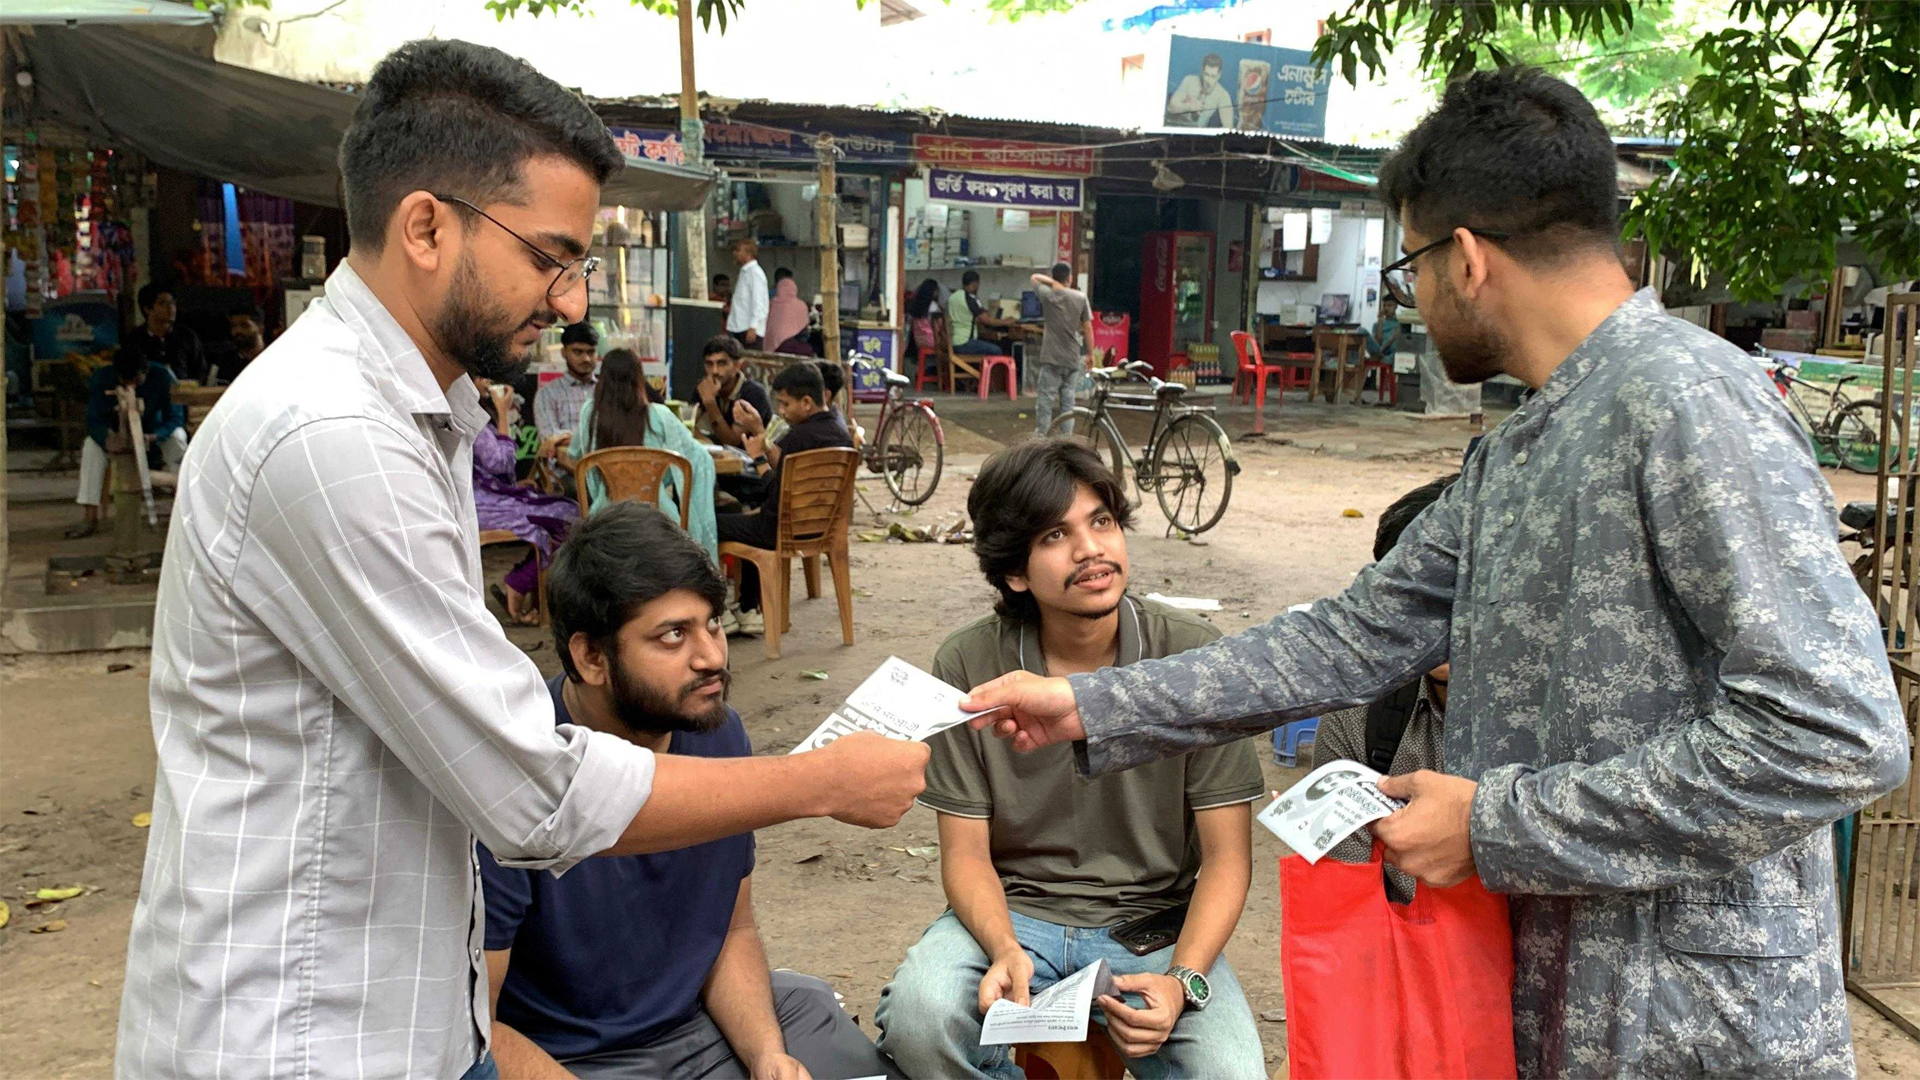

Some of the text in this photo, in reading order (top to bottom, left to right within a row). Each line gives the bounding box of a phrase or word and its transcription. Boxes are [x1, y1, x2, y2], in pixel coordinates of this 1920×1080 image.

[934, 173, 964, 193] ভর্তি
[1029, 184, 1053, 200] করা
[1056, 185, 1075, 202] হয়
